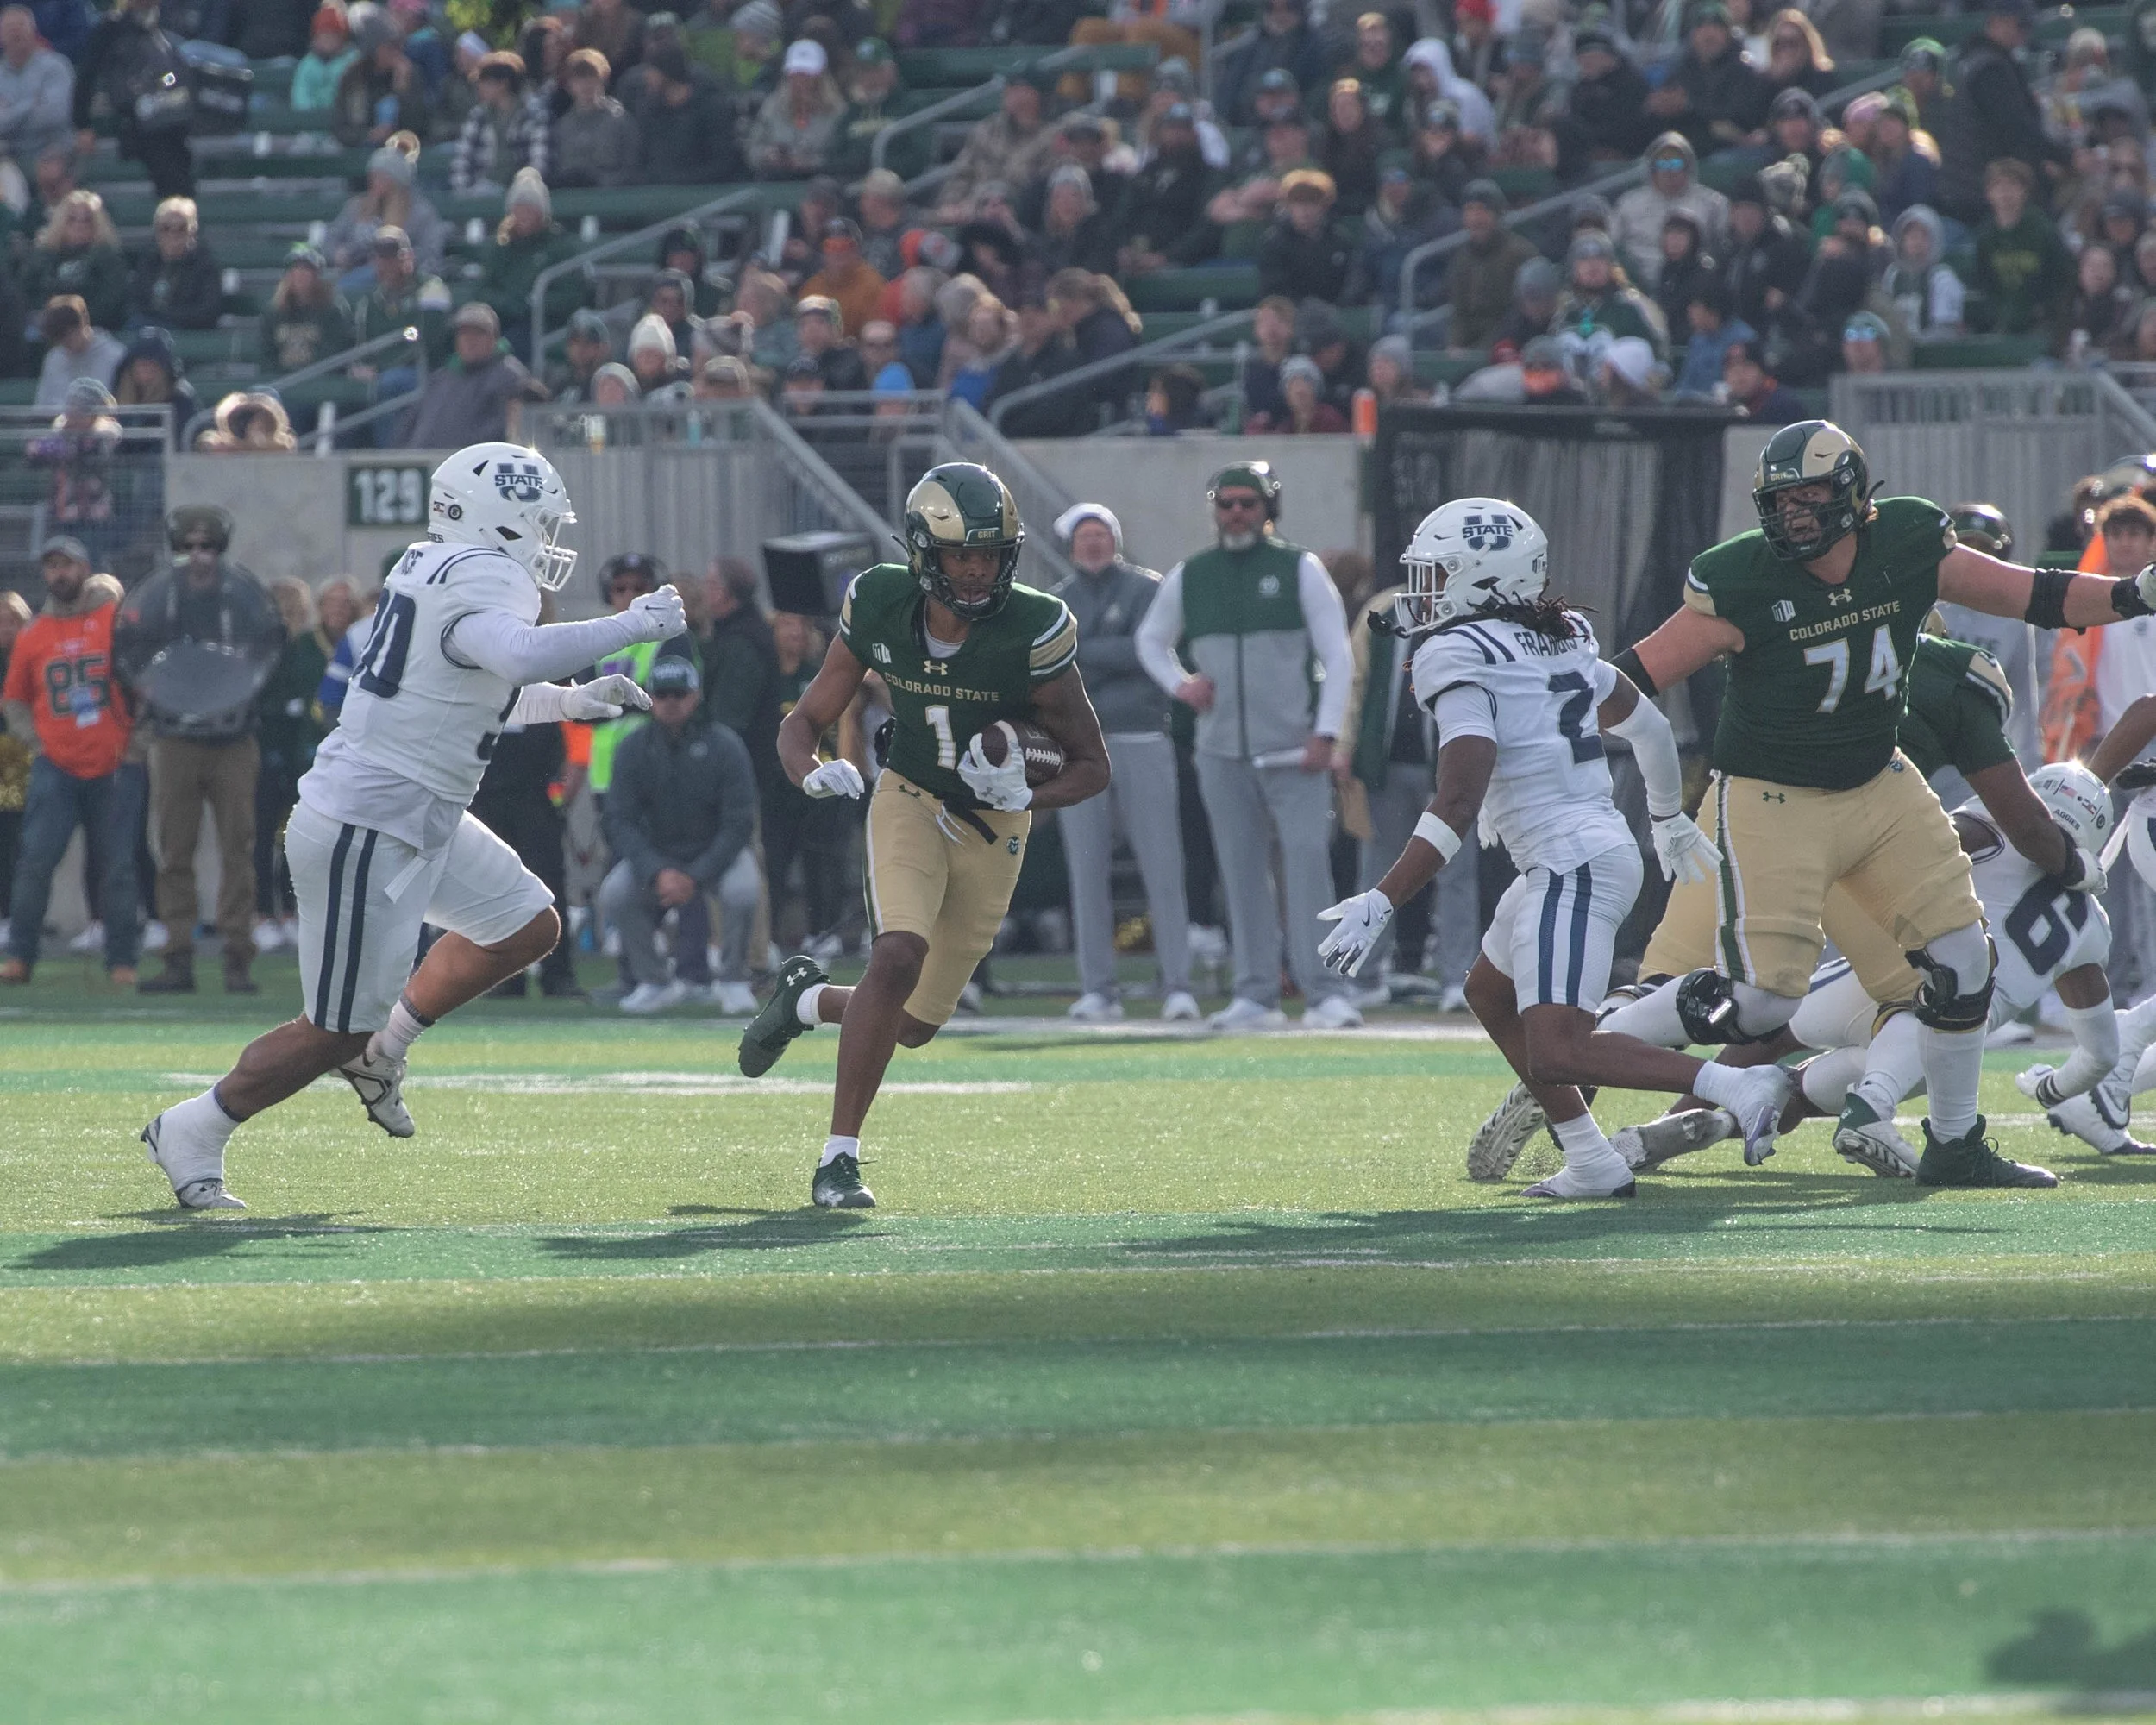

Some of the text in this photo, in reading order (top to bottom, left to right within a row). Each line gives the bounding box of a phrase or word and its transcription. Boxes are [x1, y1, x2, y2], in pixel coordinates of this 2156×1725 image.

[355, 467, 423, 523] 129
[494, 474, 542, 489] STATE
[977, 530, 996, 539] GRIT
[1462, 524, 1514, 539] STATE
[1789, 600, 1901, 641] COLORADO STATE
[46, 653, 111, 718] 85
[884, 672, 999, 702] COLORADO STATE
[1803, 624, 1903, 714] 74
[925, 705, 956, 770] 1
[1547, 668, 1607, 765] 2
[2003, 875, 2088, 976] 6
